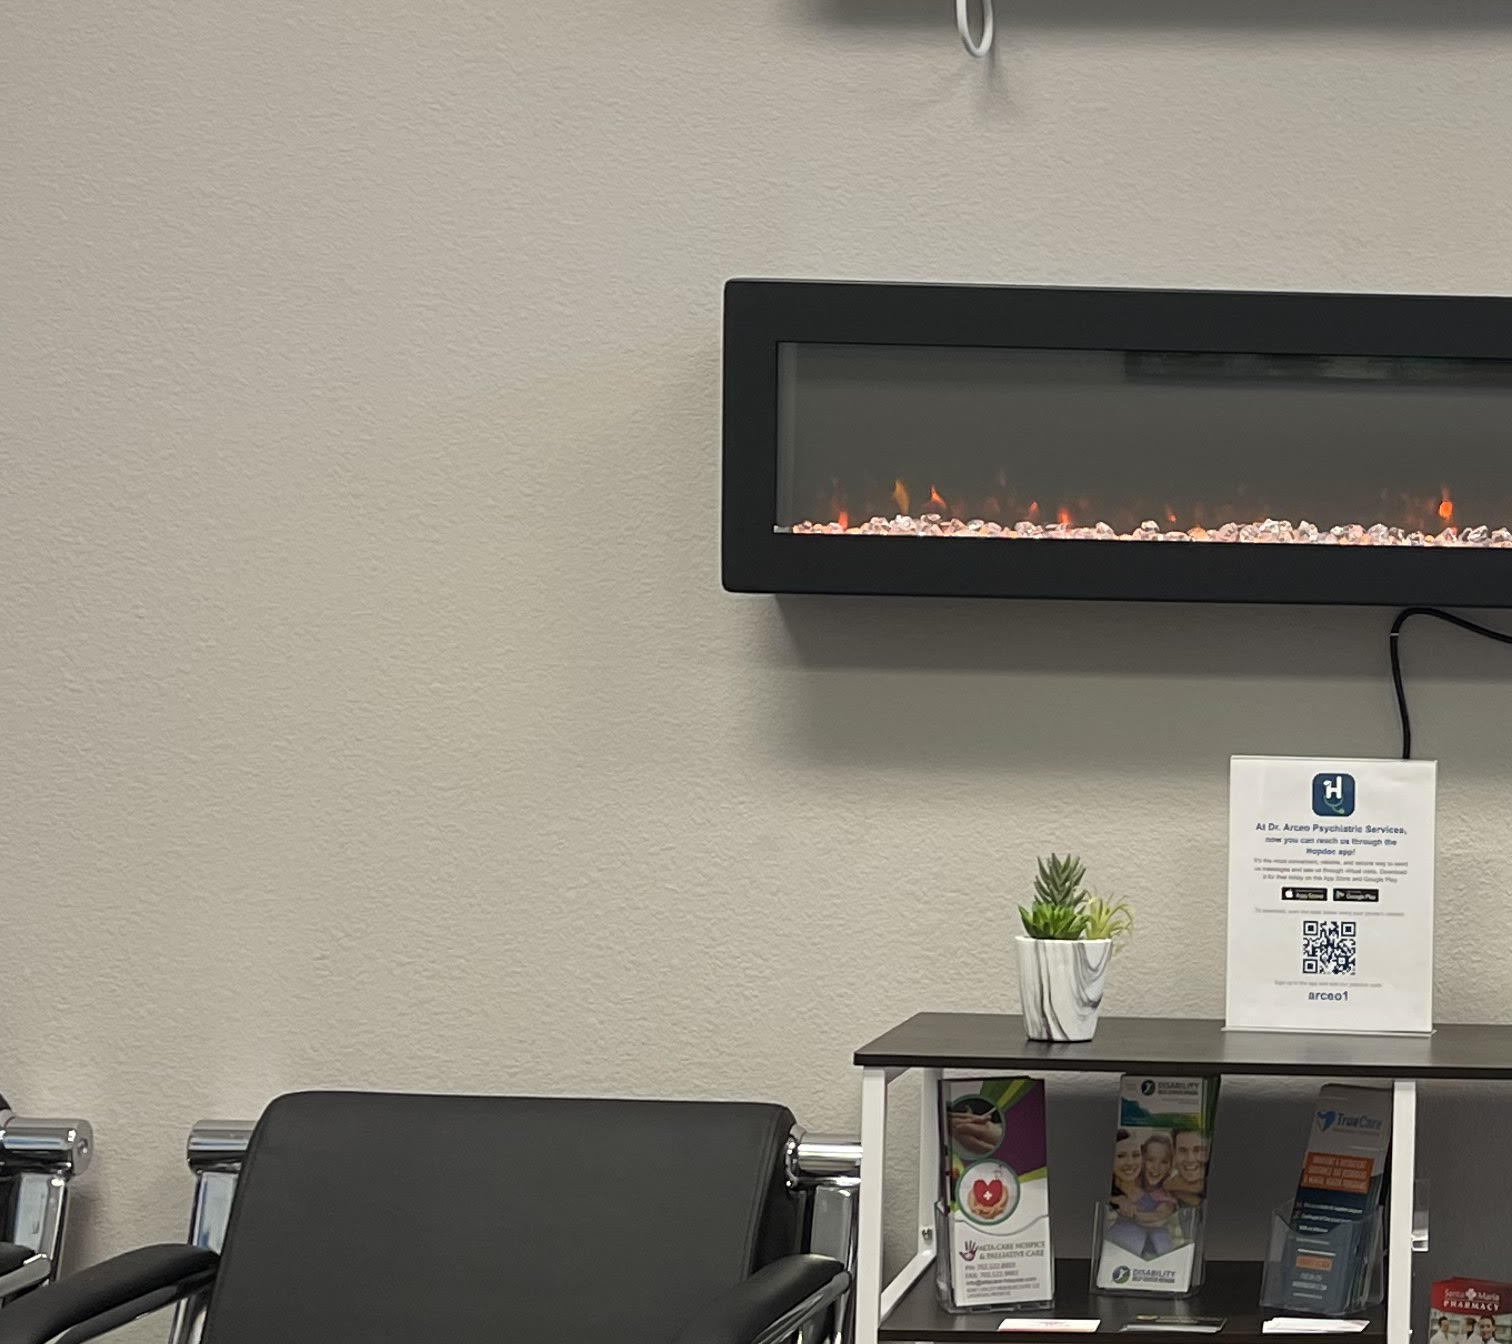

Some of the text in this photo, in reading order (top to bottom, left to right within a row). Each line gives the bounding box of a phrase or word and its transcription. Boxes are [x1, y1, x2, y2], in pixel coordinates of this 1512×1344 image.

[1255, 822, 1266, 831] At
[1268, 823, 1281, 832] Dr.
[1312, 824, 1363, 834] Psychiatric
[1365, 825, 1408, 836] Services,
[1316, 837, 1339, 845] reach
[1352, 838, 1383, 847] through
[1443, 1299, 1499, 1312] PHARMACY
